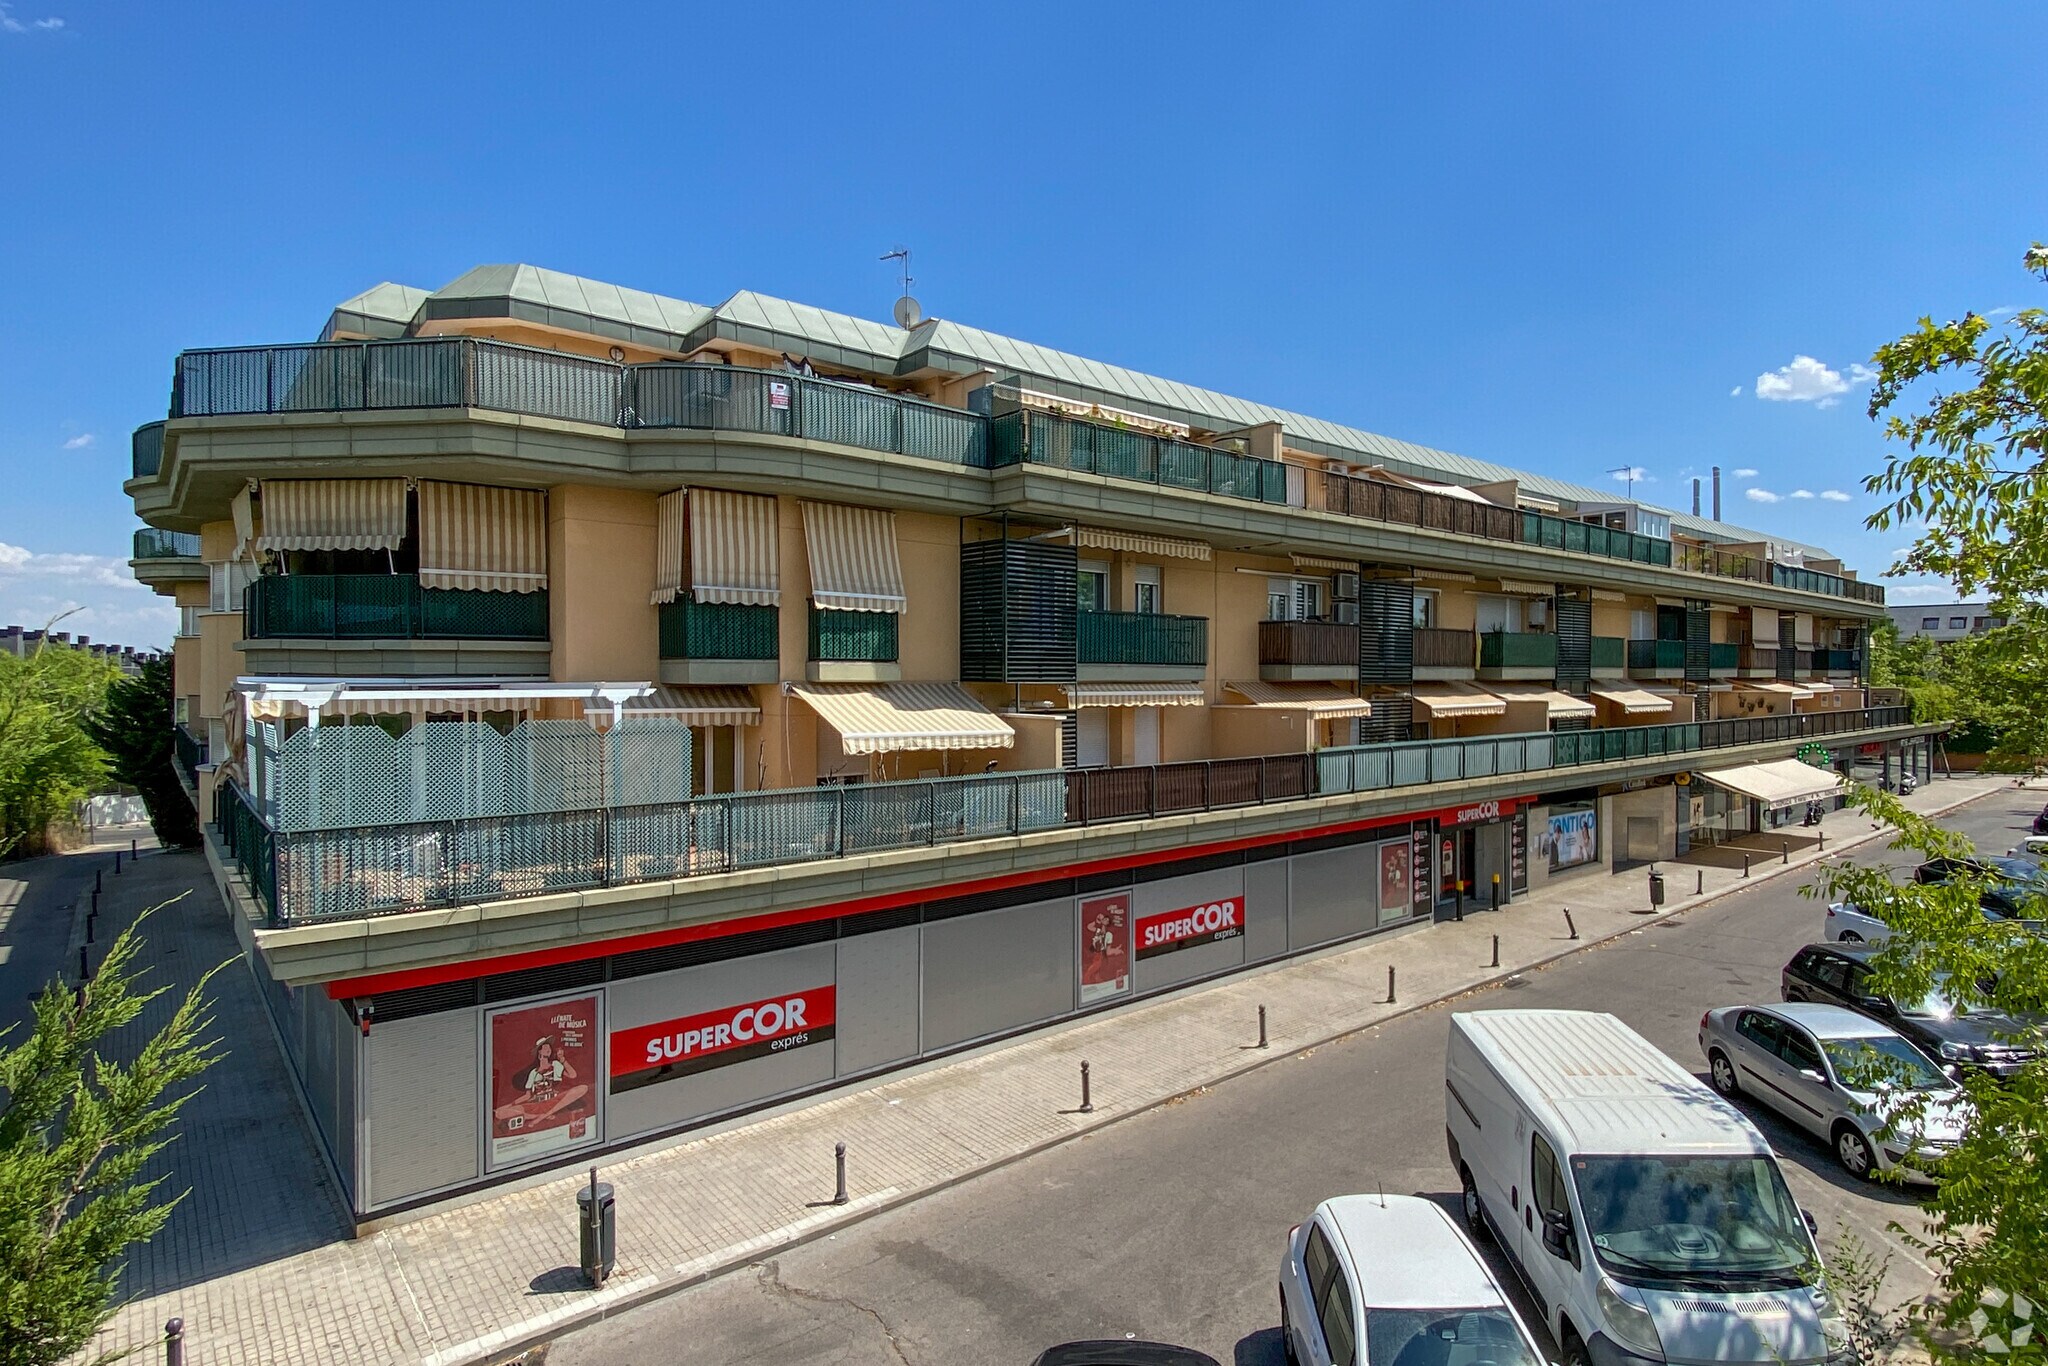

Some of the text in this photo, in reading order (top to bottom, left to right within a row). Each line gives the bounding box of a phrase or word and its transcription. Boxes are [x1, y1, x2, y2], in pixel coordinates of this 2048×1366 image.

[1457, 801, 1499, 823] SUPERCOR
[1548, 812, 1594, 836] CONTIGO
[1144, 901, 1235, 946] SUPERCOR
[1214, 927, 1236, 941] exprés
[567, 1019, 586, 1028] MÚSICA
[646, 998, 808, 1063] SUPERCOR
[770, 1031, 809, 1050] exprés
